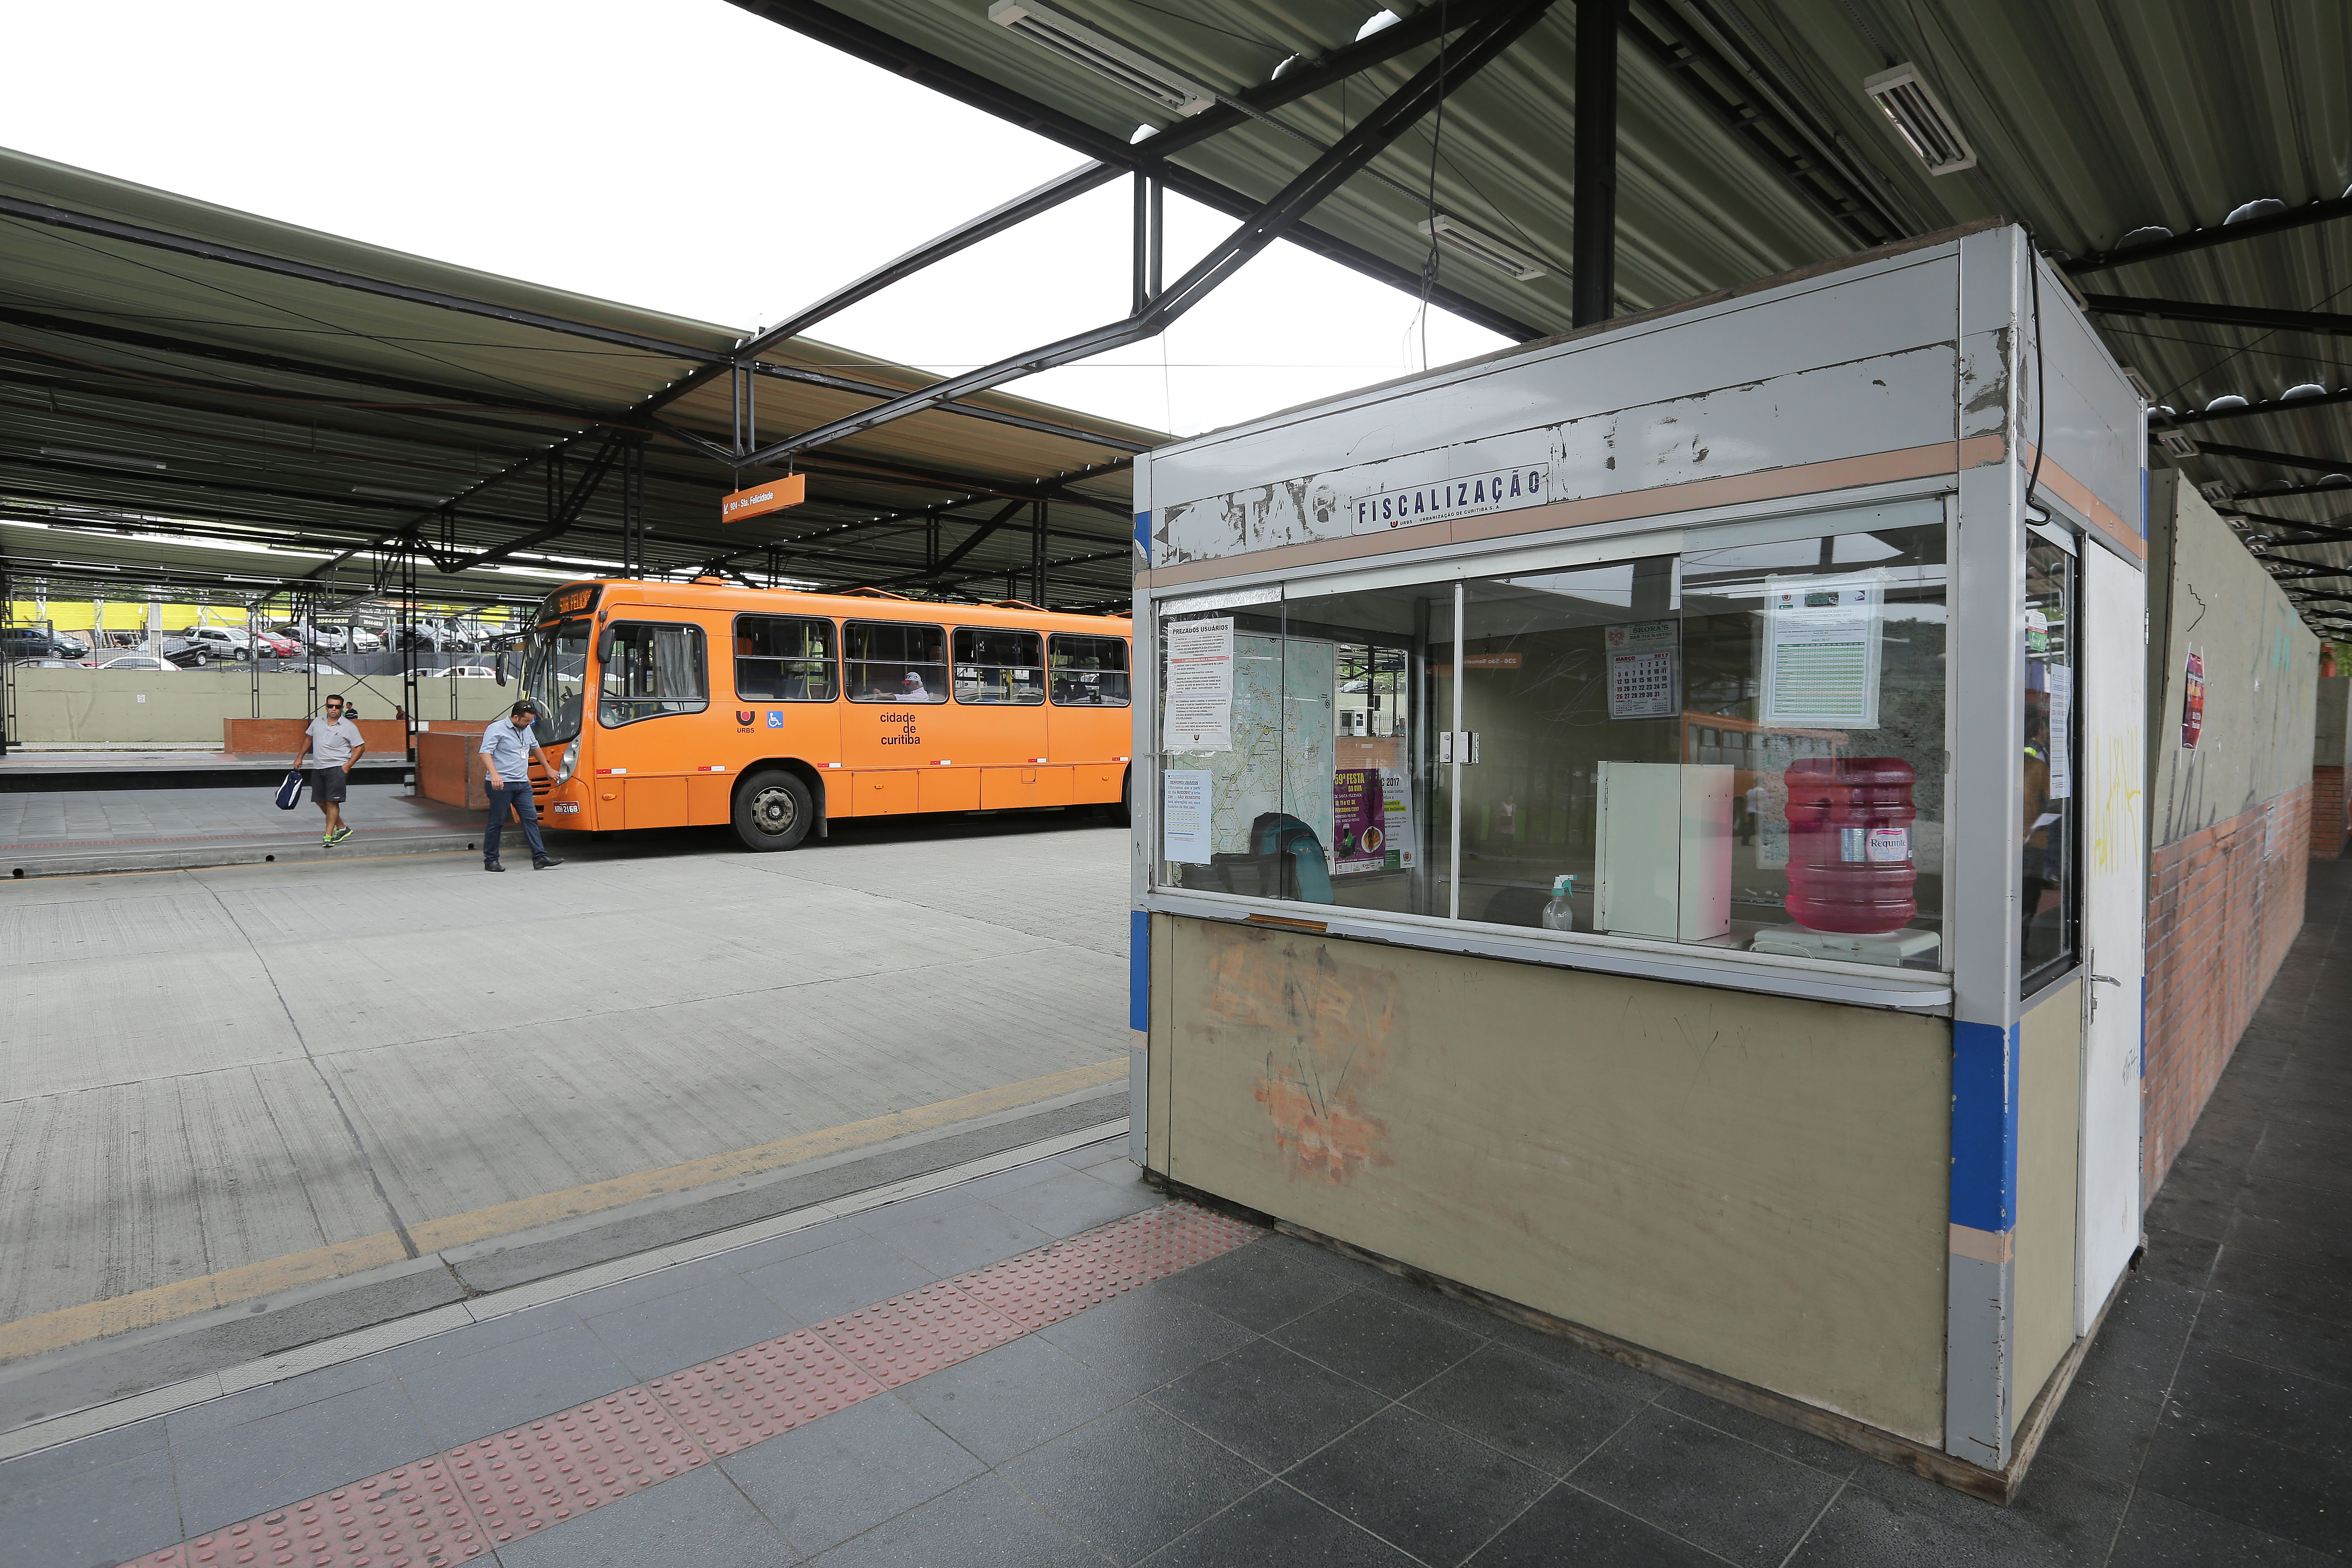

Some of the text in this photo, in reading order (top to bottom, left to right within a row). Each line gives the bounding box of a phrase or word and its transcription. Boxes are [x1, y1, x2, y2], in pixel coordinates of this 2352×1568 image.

[741, 499, 749, 507] Sta.
[750, 491, 773, 505] Felicidade
[1359, 469, 1539, 523] FISCALIZAÇÃO
[1633, 625, 1668, 633] SKORA'S
[880, 713, 915, 722] cidade
[881, 735, 920, 744] curitiba
[1346, 773, 1365, 784] FESTA
[1387, 778, 1399, 786] 2017
[1871, 839, 1906, 848] Requinte
